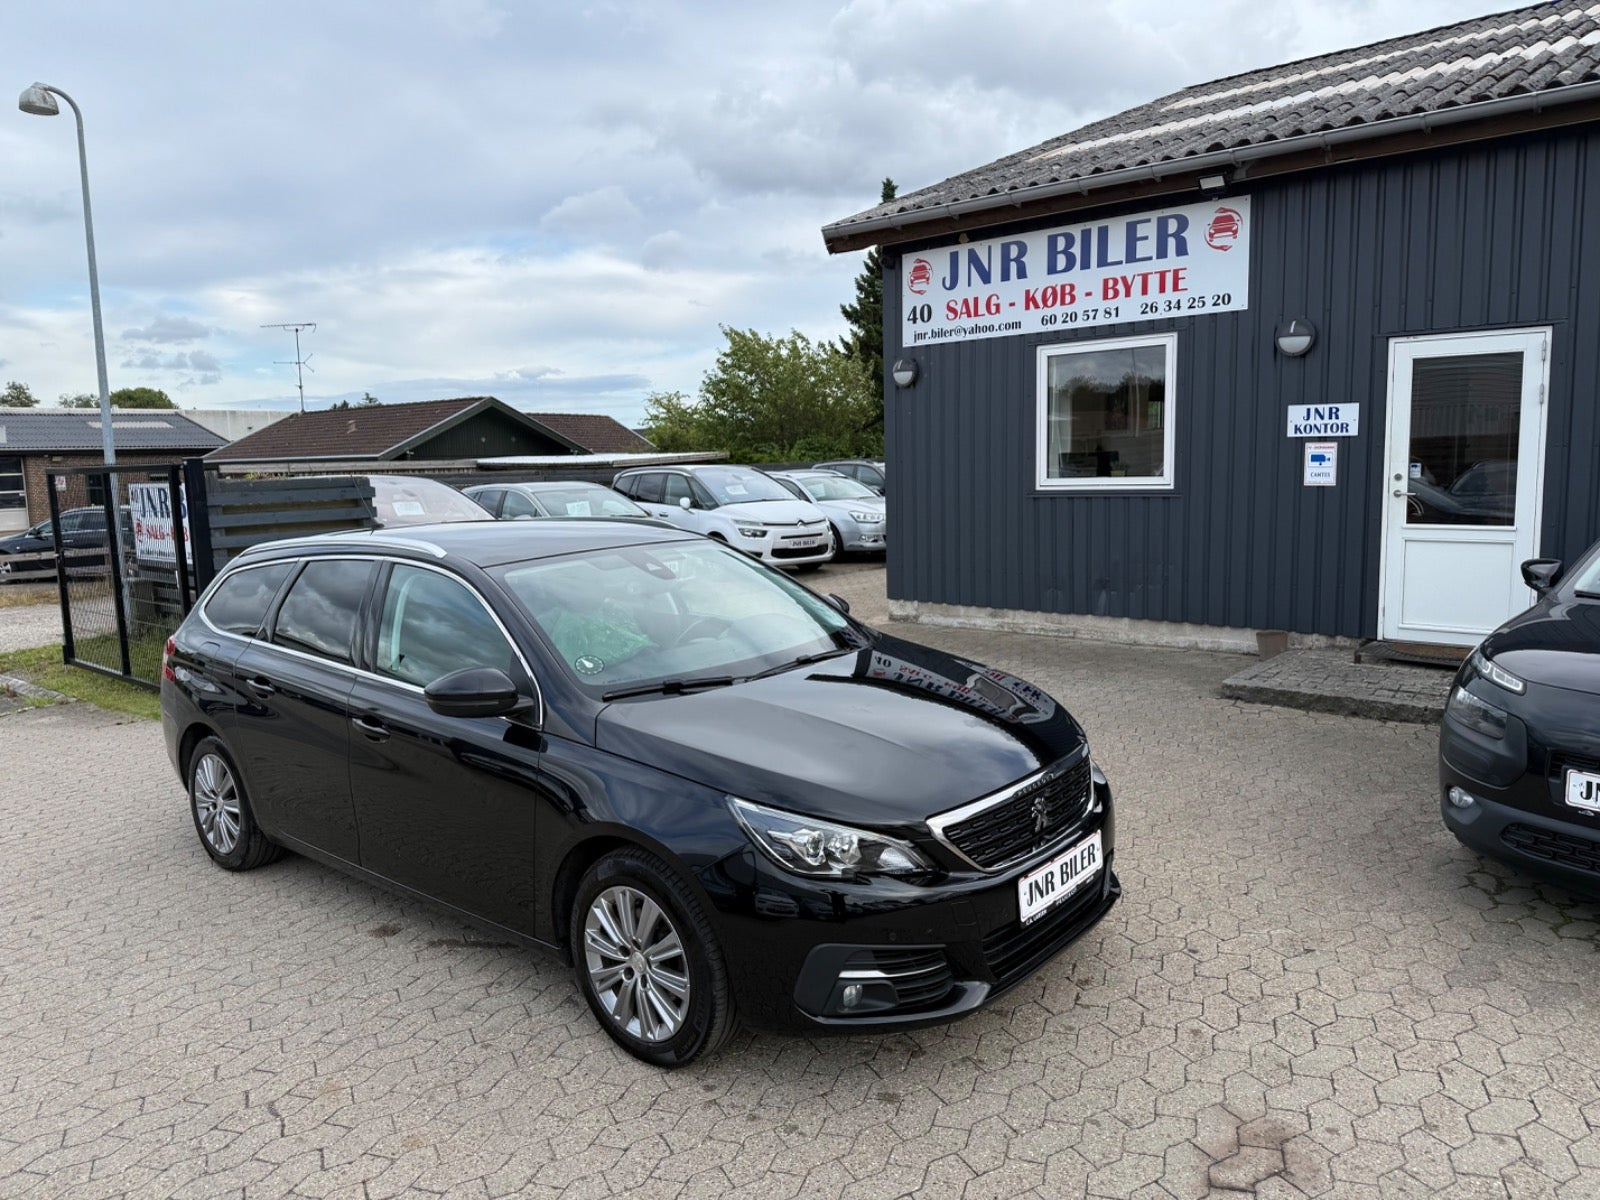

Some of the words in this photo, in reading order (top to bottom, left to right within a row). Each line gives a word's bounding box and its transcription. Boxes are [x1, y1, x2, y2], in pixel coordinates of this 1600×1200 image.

[942, 240, 1028, 290] JNR
[1047, 213, 1189, 275] BILER
[946, 293, 1000, 320] SALG
[1024, 282, 1076, 311] KØB
[1102, 267, 1188, 301] BYTTE
[907, 303, 932, 324] 40
[1041, 314, 1057, 326] 60
[1061, 311, 1078, 324] 20
[1082, 308, 1099, 321] 57
[1103, 306, 1120, 319] 81
[1140, 301, 1158, 315] 26
[1163, 299, 1182, 312] 34
[1187, 296, 1206, 309] 25
[1211, 293, 1232, 307] 20
[913, 320, 1022, 343] jnr.biler@yahoo.com
[1303, 406, 1340, 421] JNR
[1294, 422, 1349, 435] KONTOR
[1026, 870, 1055, 907] JNR
[1060, 843, 1096, 886] BILER
